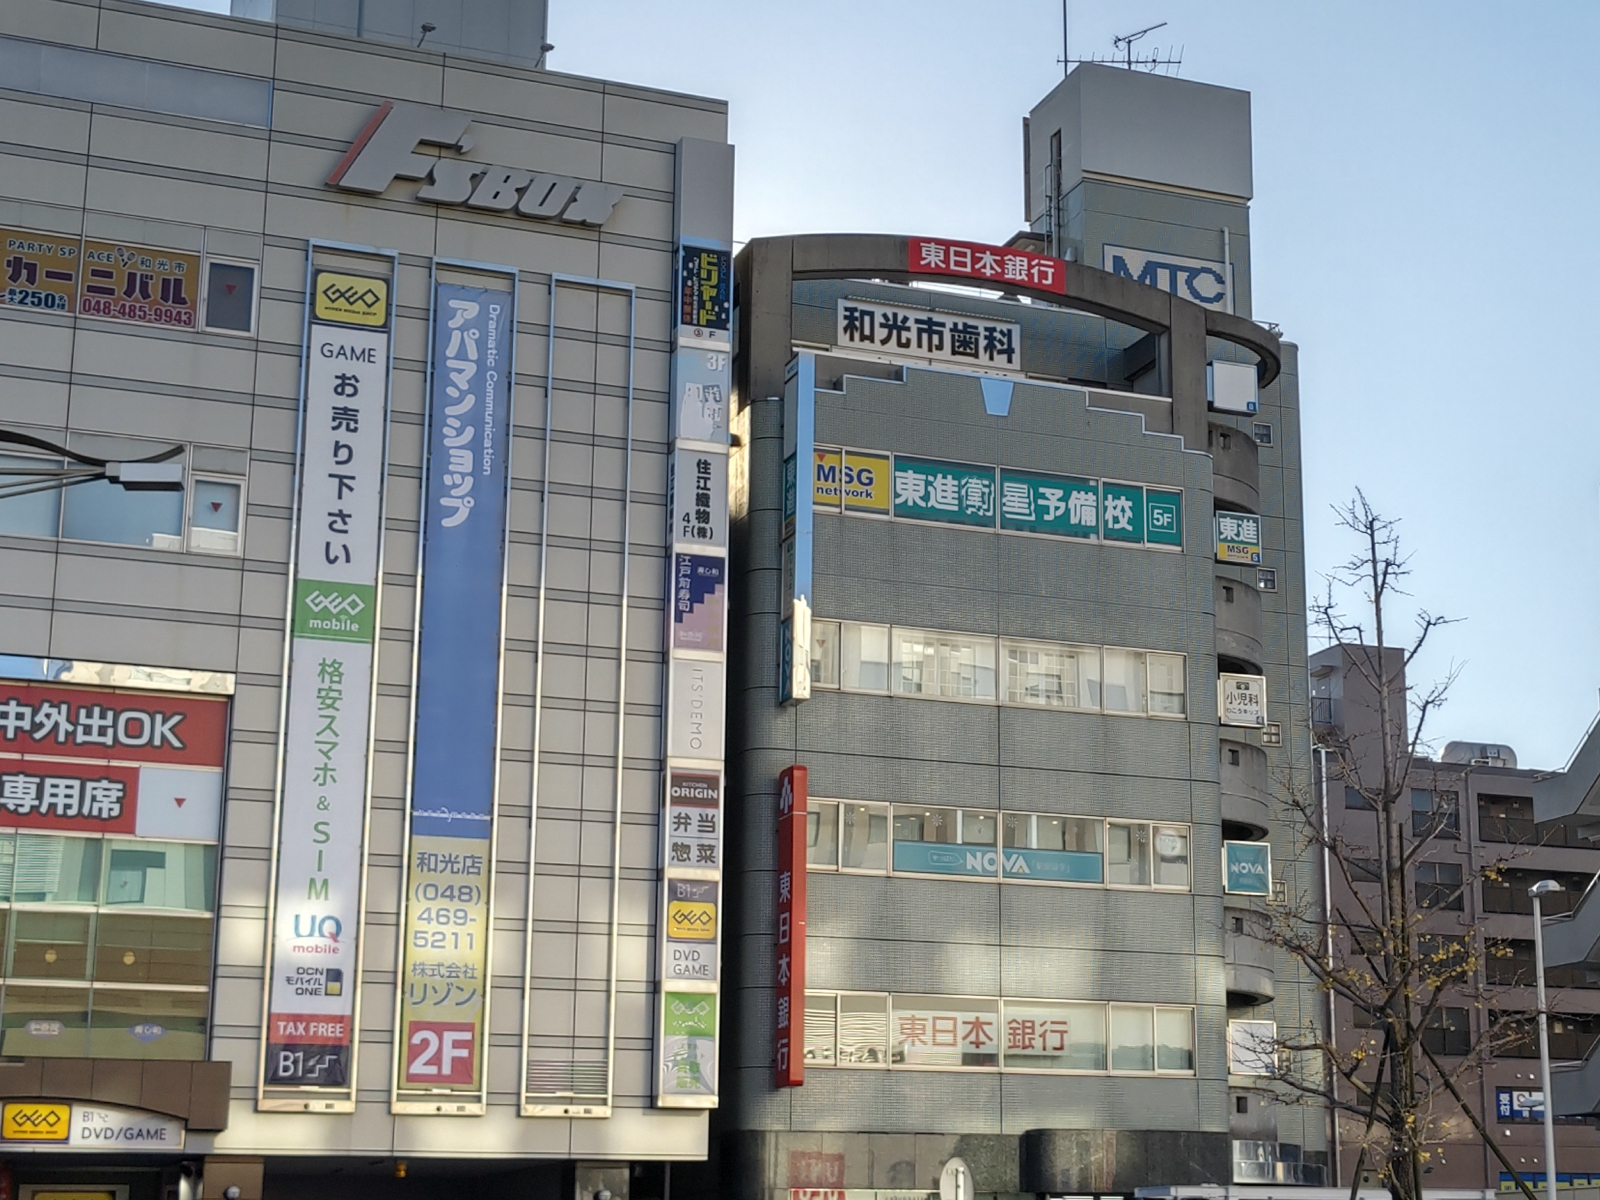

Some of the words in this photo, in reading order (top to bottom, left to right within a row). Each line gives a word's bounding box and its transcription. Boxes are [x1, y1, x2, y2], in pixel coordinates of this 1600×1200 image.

[8, 239, 54, 254] PARTY
[140, 257, 187, 272] 和光市
[919, 242, 1055, 285] 東日本銀行
[6, 256, 188, 305] カーニバル
[700, 252, 719, 326] ビリヤード
[1112, 255, 1226, 304] MTC
[82, 298, 193, 326] 048-485-9943
[487, 304, 500, 367] Dramatic
[843, 306, 1015, 364] 和光市歯科
[321, 343, 377, 364] GAME
[707, 354, 726, 371] 3F
[440, 300, 479, 527] アパマンショップ
[482, 371, 498, 475] Communication
[325, 373, 359, 564] お売り下さい
[817, 464, 874, 487] MSG
[816, 486, 873, 499] network
[895, 470, 1133, 531] 東進衛星予備校
[1153, 509, 1172, 527] 5F
[1219, 517, 1257, 543] 東進
[1227, 545, 1249, 554] MSG
[678, 555, 692, 612] 江戸前寿司
[309, 617, 359, 632] mobile
[1227, 692, 1259, 707] 小児科
[0, 700, 184, 748] 中外出OK
[1, 774, 124, 819] 専用席
[671, 787, 718, 799] ORIGIN
[672, 812, 716, 834] 弁当
[416, 852, 483, 876] 和光店
[672, 842, 716, 864] 惣菜
[966, 851, 1031, 874] NOVA
[1230, 863, 1265, 874] NOVA
[415, 883, 481, 905] (048)
[293, 914, 342, 943] UQ
[292, 944, 340, 954] mobile
[413, 930, 474, 950] 5211
[673, 950, 700, 961] DVD
[296, 967, 324, 976] OCN
[411, 962, 478, 979] 株式会社
[673, 963, 709, 976] GAME
[777, 871, 791, 1071] 東日本銀行
[285, 976, 323, 986] モバイル
[295, 987, 323, 996] ONE
[410, 983, 477, 1006] リゾン
[277, 1021, 306, 1036] TAX
[309, 1022, 344, 1037] FREE
[898, 1014, 1069, 1051] 東日本銀行
[409, 1030, 472, 1075] 2F
[278, 1052, 303, 1077] B1
[82, 1111, 94, 1123] B1
[81, 1127, 167, 1141] DVD/GAME
